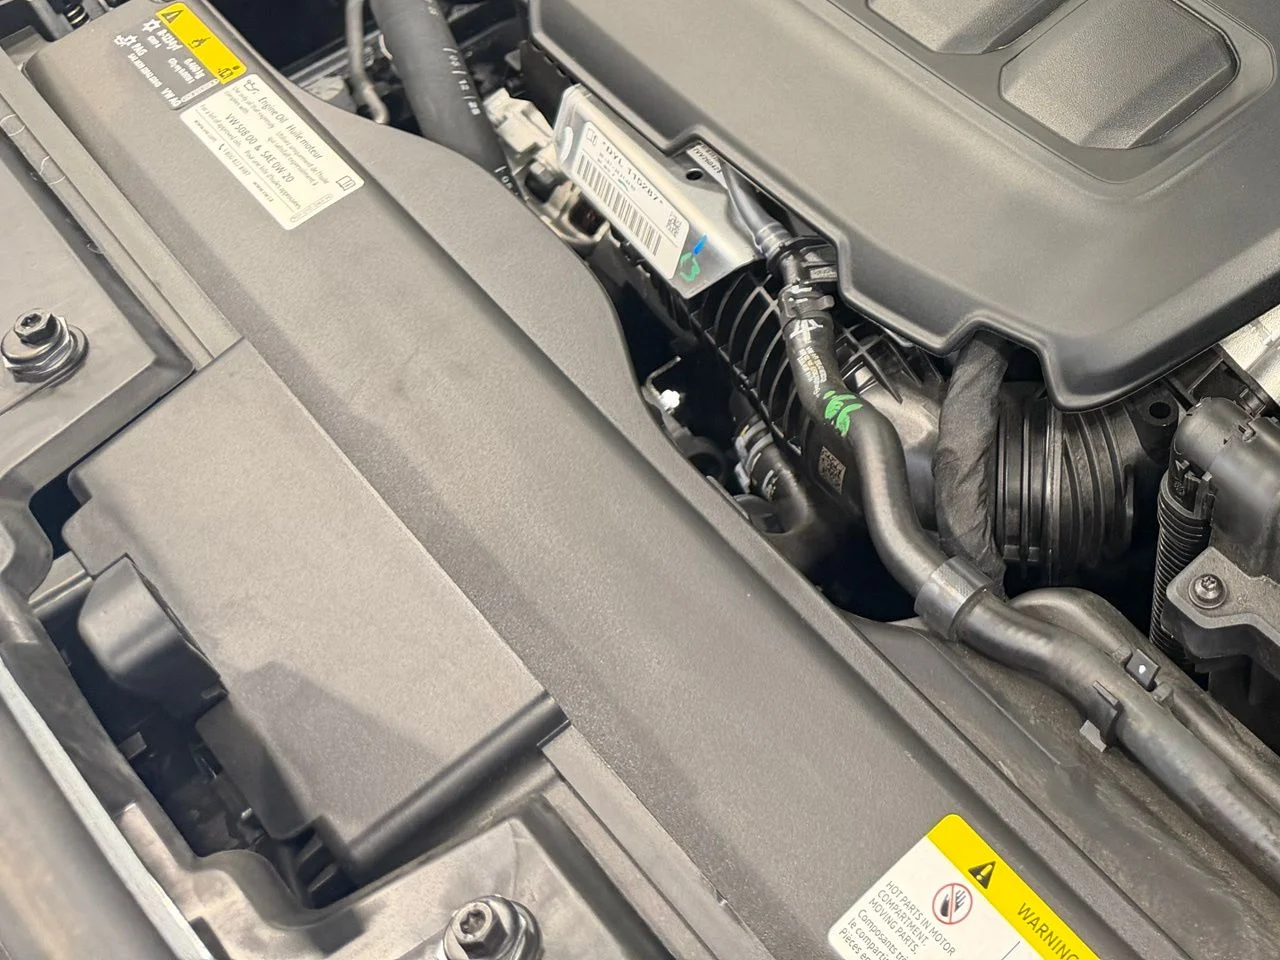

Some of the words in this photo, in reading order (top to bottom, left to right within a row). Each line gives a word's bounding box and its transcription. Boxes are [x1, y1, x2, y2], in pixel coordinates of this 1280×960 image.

[159, 87, 175, 99] VW
[255, 96, 281, 117] Engine
[274, 112, 288, 124] Oil
[223, 112, 241, 126] VW
[233, 123, 250, 136] 508
[243, 133, 259, 145] 00
[252, 143, 265, 152] &
[259, 149, 276, 164] SAE
[284, 123, 305, 140] Huile
[298, 137, 324, 160] moteur
[846, 917, 859, 929] le
[866, 896, 899, 930] MOVING
[884, 880, 903, 899] HOT
[898, 895, 924, 921] PARTS
[919, 917, 932, 930] IN
[927, 925, 957, 956] MOTOR
[837, 926, 864, 954] Pièces
[854, 907, 901, 955] Composants
